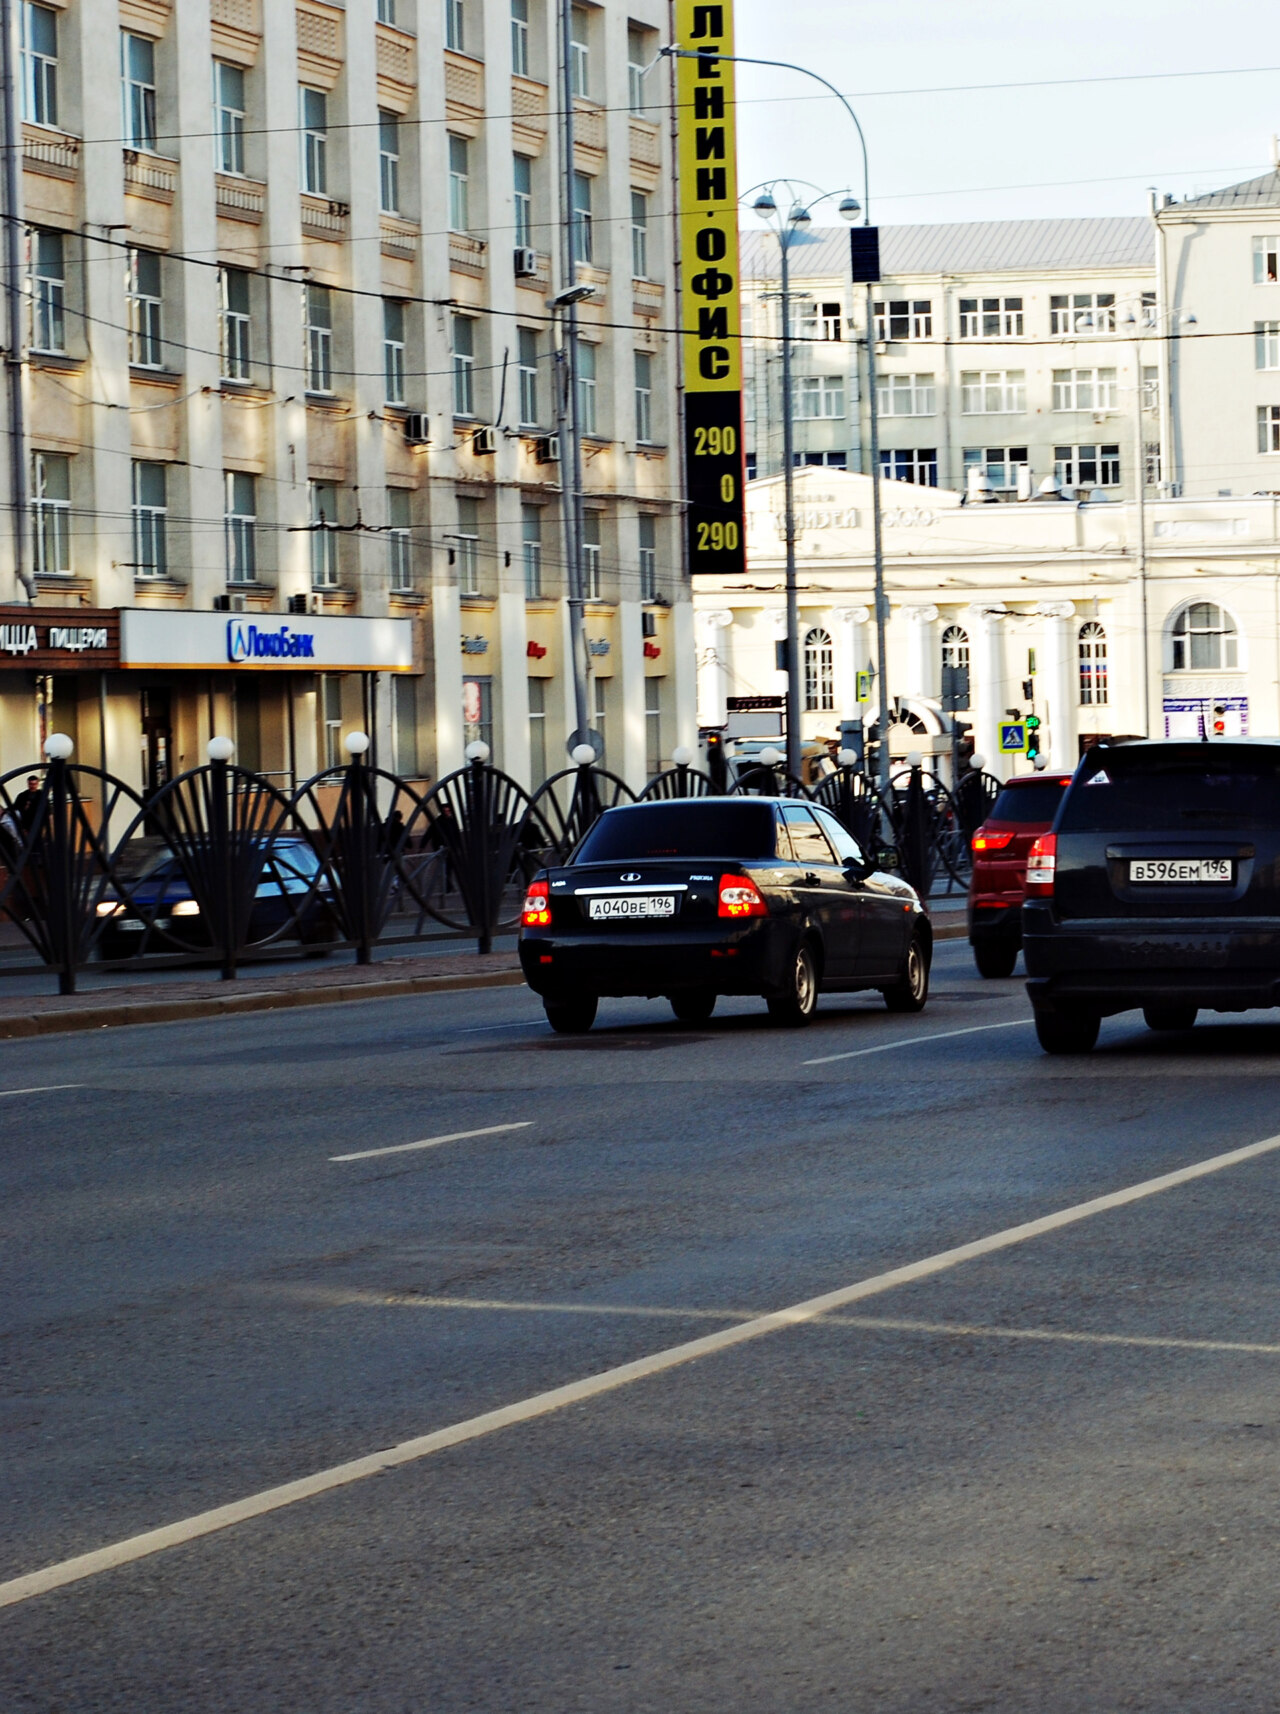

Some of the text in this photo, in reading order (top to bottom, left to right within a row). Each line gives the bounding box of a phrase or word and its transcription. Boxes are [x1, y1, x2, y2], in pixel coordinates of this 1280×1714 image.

[690, 4, 733, 380] ЛЕНИН ОФИС
[694, 426, 736, 456] 290
[720, 473, 735, 503] 0
[697, 521, 738, 551] 290
[49, 628, 108, 653] ПИЦЦЕРИЯ
[1203, 860, 1228, 874] 196
[650, 898, 672, 909] 196
